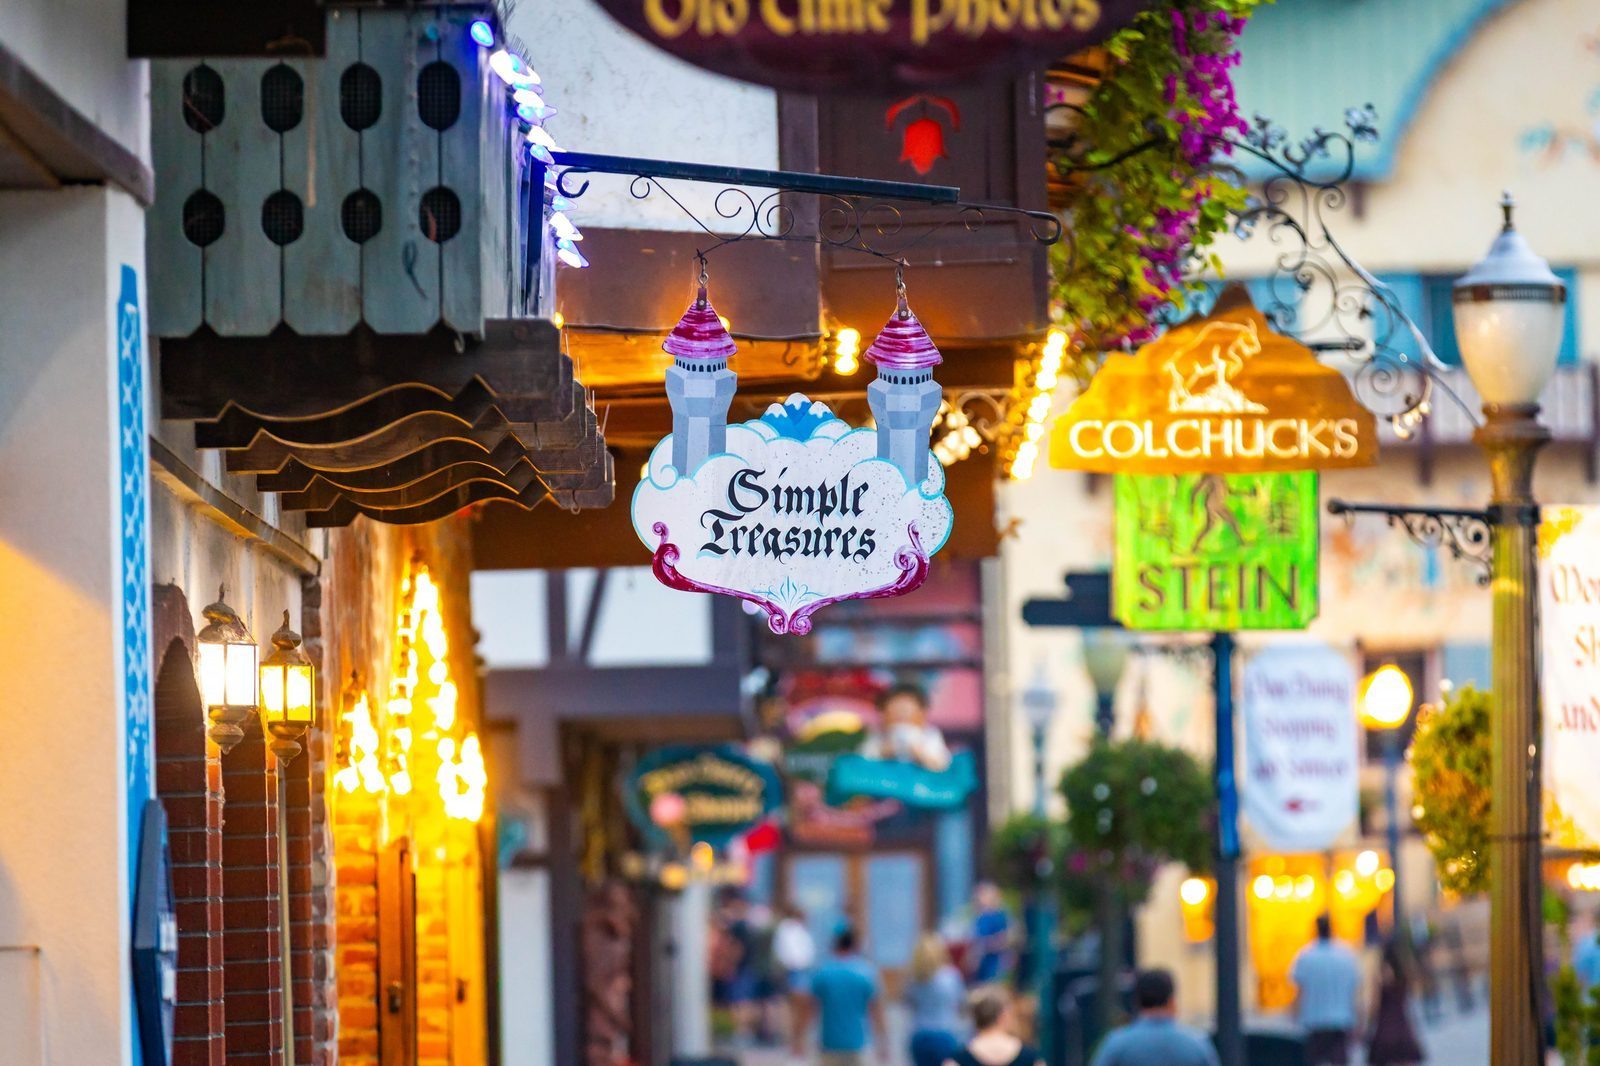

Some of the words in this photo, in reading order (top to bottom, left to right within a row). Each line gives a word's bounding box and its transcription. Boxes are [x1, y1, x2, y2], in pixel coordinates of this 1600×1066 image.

[1069, 418, 1358, 458] COLCHUCK'S
[728, 467, 869, 527] Simple
[700, 509, 876, 564] Treasures
[1138, 563, 1299, 612] STEIN
